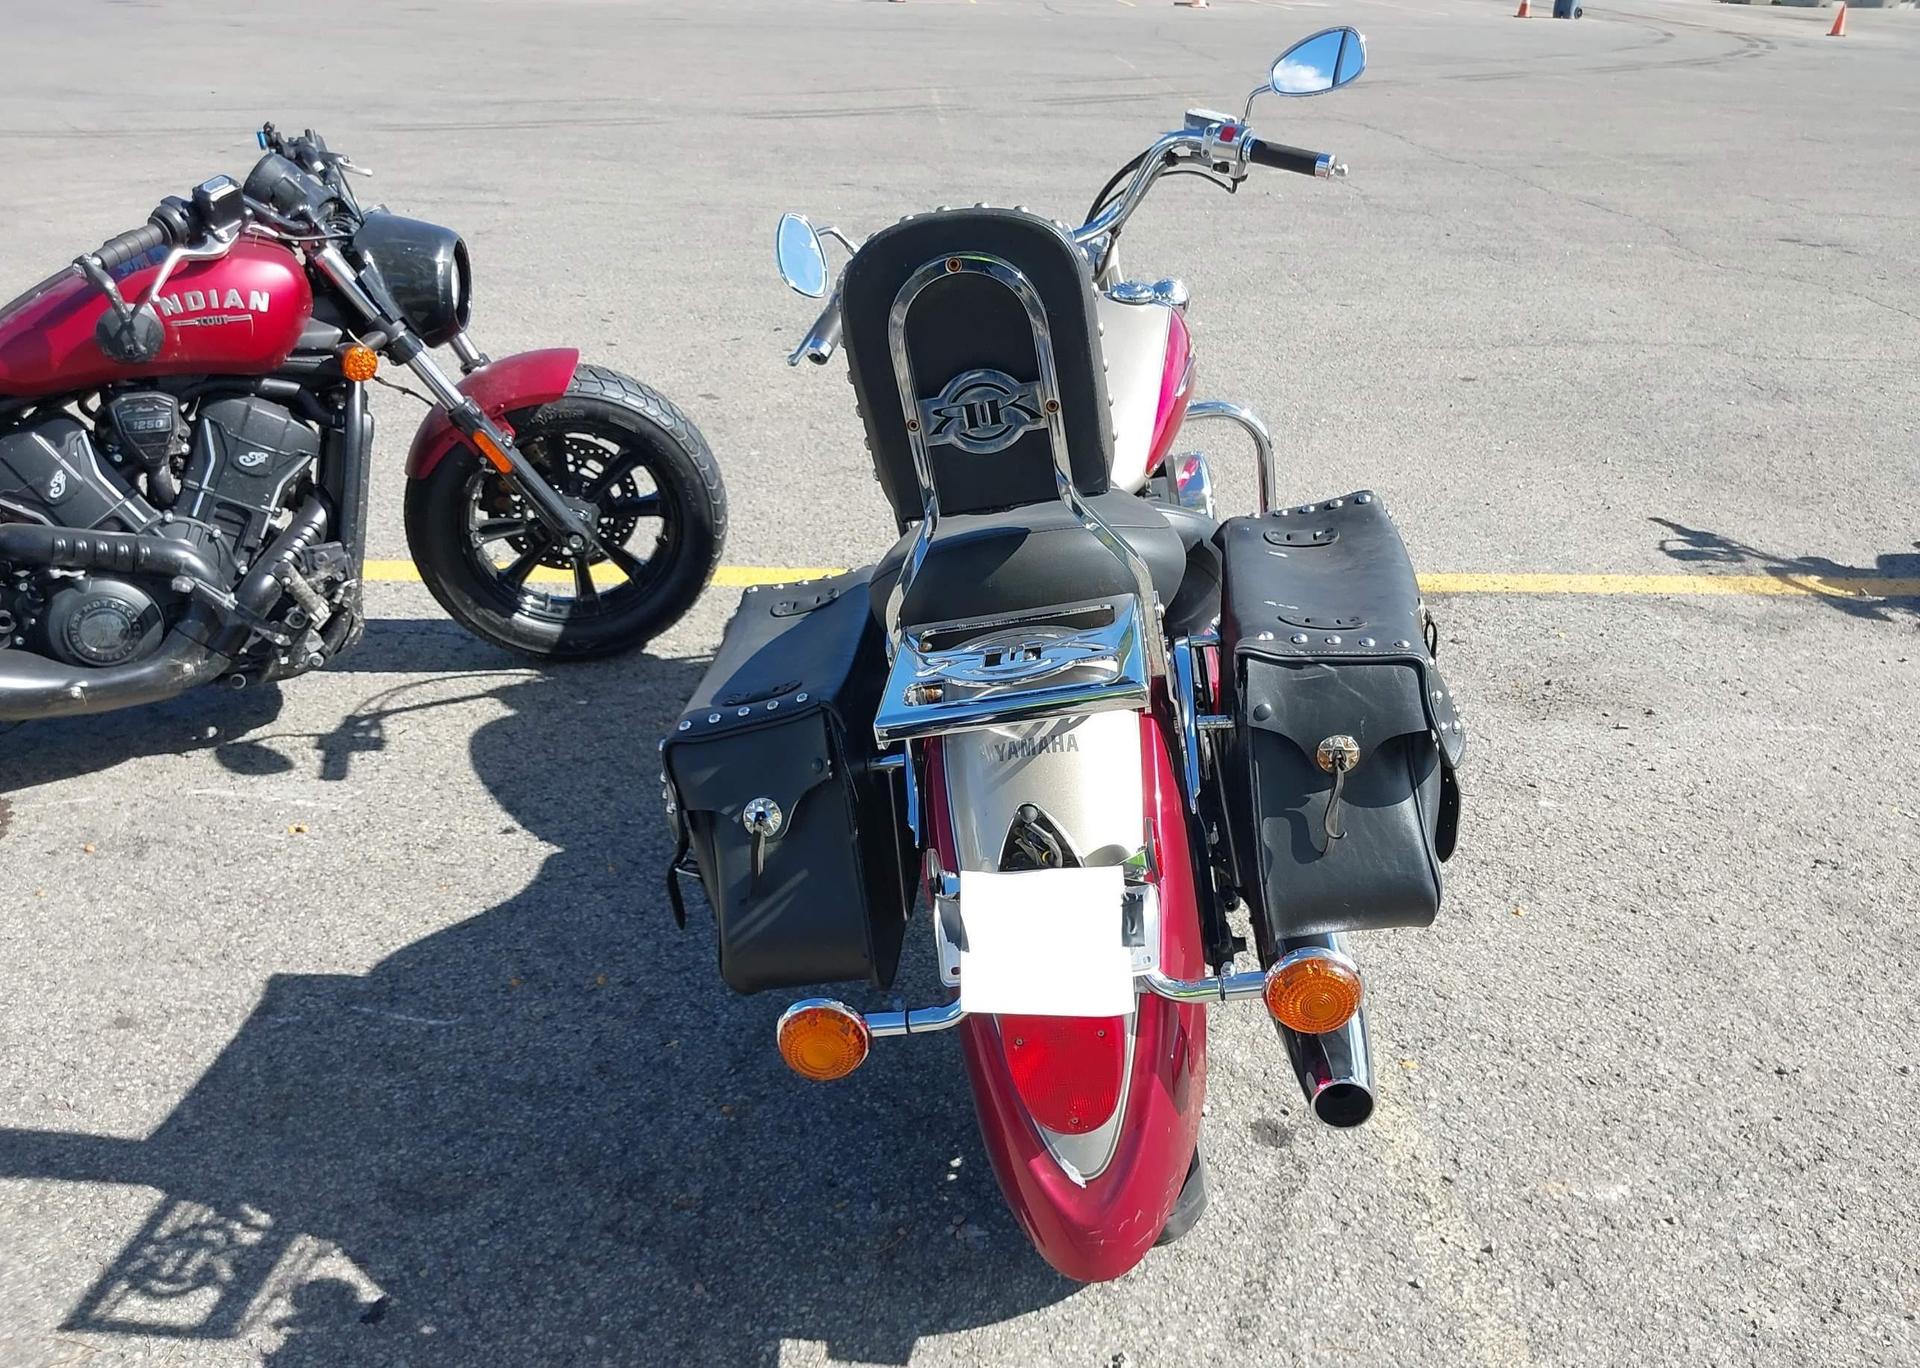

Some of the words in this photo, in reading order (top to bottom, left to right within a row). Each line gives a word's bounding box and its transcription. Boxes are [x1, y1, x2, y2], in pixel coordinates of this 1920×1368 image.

[158, 288, 271, 317] NDIAN
[133, 419, 164, 430] 1250
[994, 733, 1079, 762] YAMAHA
